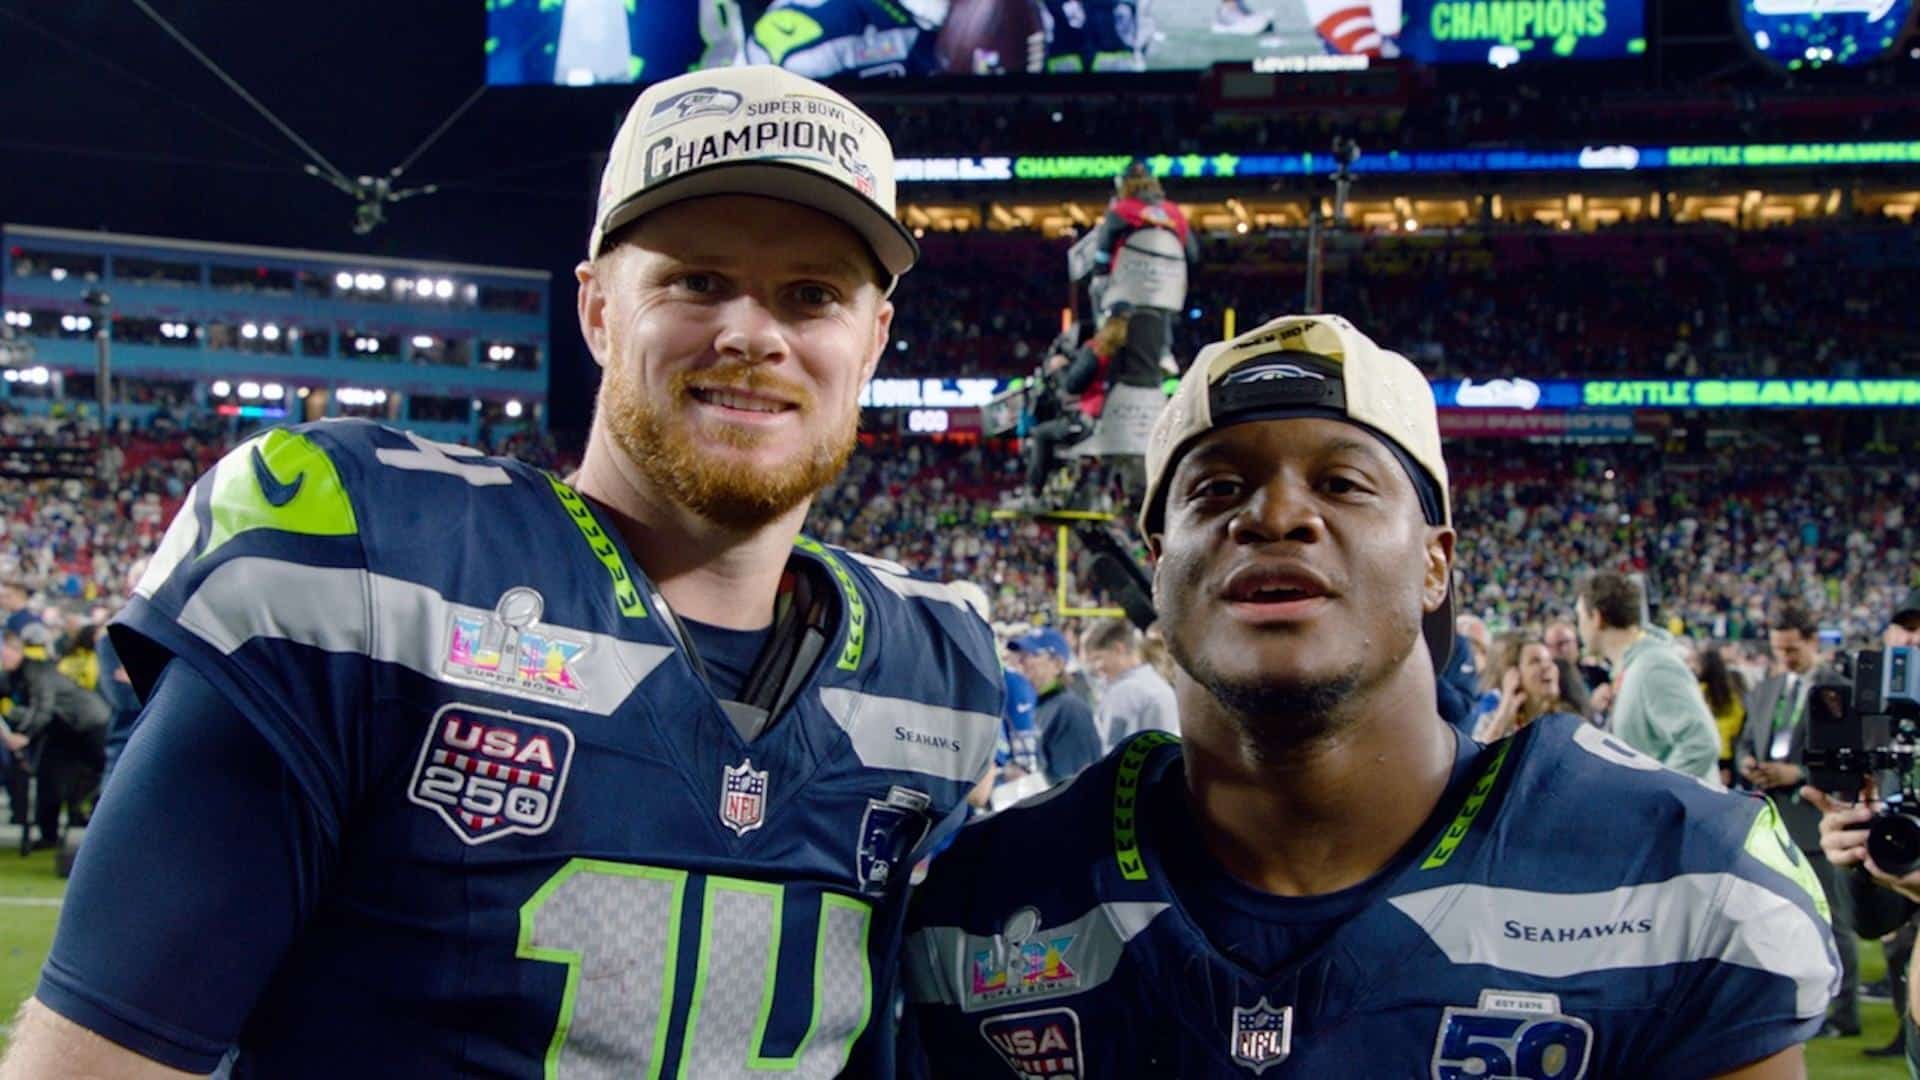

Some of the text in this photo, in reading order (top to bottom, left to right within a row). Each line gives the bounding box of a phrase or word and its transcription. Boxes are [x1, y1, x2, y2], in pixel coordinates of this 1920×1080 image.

[1431, 0, 1607, 40] CHAMPIONS
[747, 101, 802, 117] SUPER
[807, 102, 848, 124] BOWL
[644, 120, 859, 188] CHAMPIONS
[1667, 146, 1741, 167] SEATTLE
[1583, 380, 1692, 407] SEATTLE
[463, 666, 567, 696] SUPER BOWL
[442, 718, 555, 771] USA
[895, 726, 961, 753] SEAHAWS
[419, 766, 549, 825] 250
[727, 795, 761, 823] NFL
[1504, 919, 1653, 943] SEAHAWKS
[515, 857, 873, 1080] 14
[1494, 999, 1516, 1008] EST
[1239, 1031, 1282, 1061] NFL
[1437, 1013, 1592, 1080] 50
